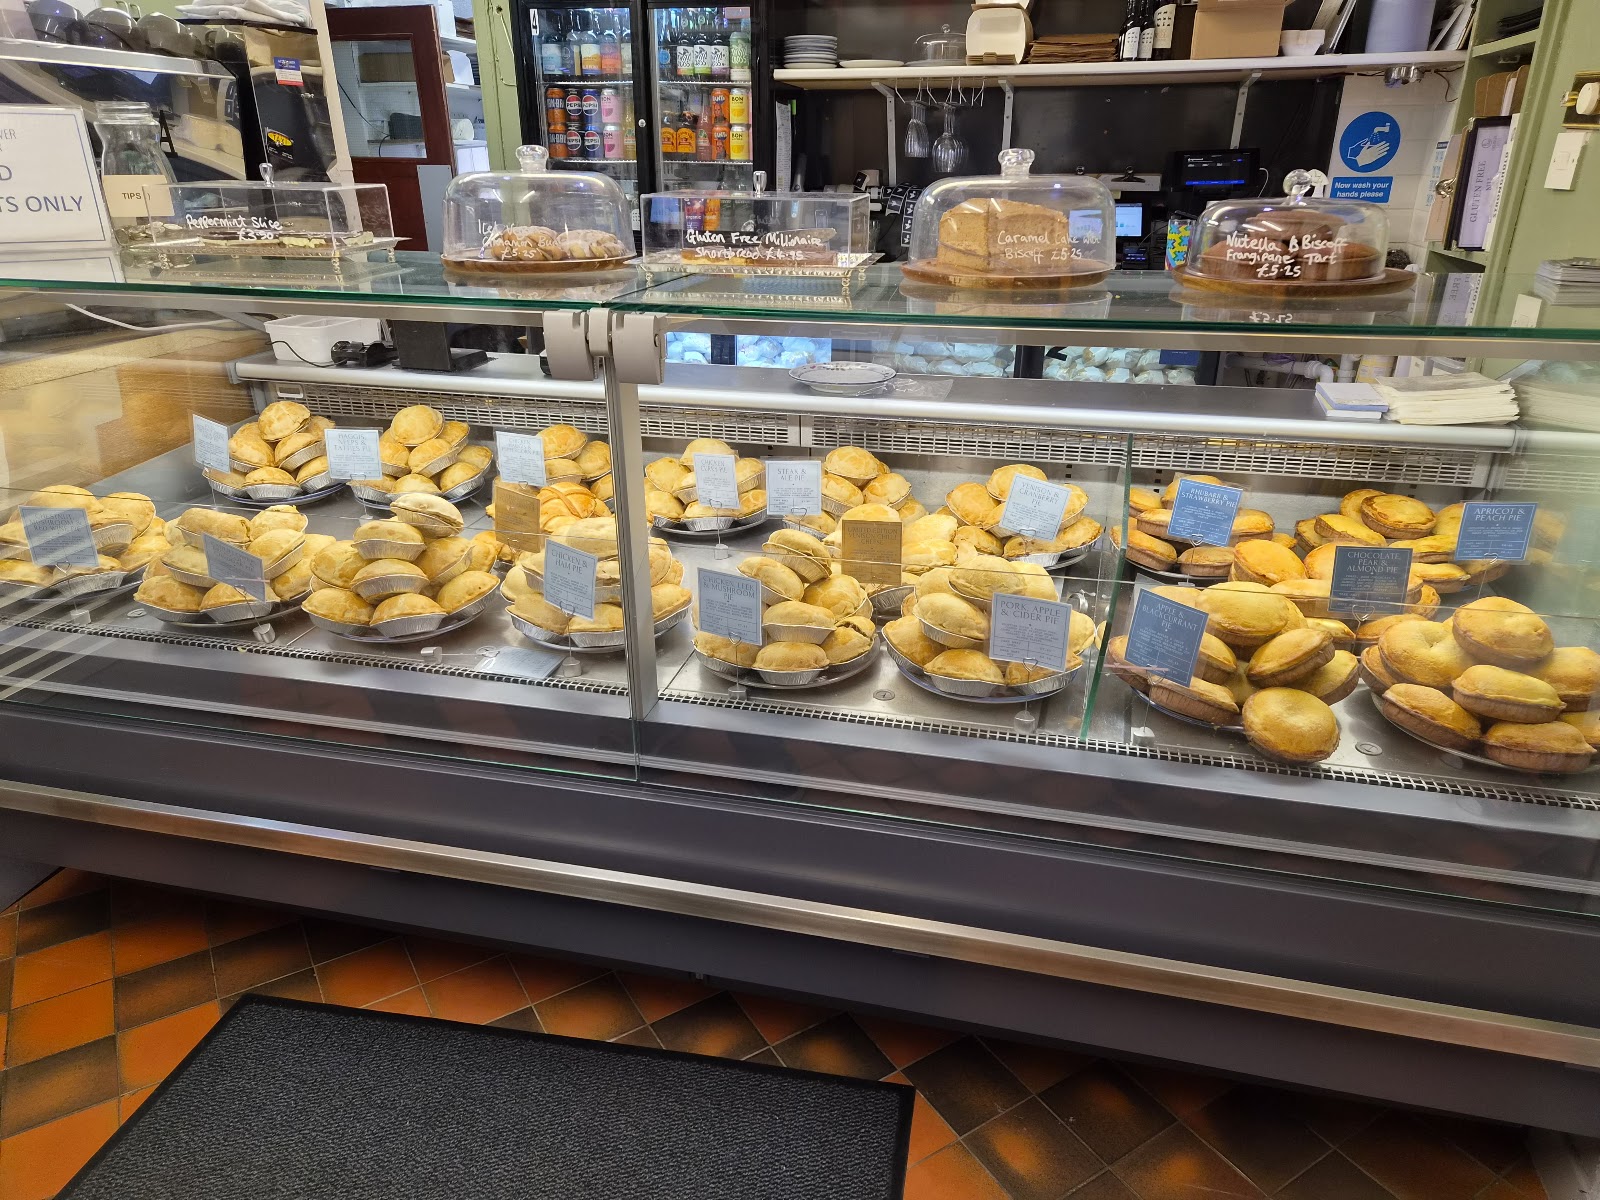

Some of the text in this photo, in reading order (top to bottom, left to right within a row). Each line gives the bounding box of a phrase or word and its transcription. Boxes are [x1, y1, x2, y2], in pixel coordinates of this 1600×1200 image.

[531, 10, 538, 34] 4
[1372, 182, 1390, 190] your
[1470, 160, 1486, 222] GLUTEN FREE
[122, 192, 142, 200] TIPS
[1360, 191, 1384, 199] please
[26, 196, 82, 212] ONLY
[186, 214, 283, 230] Peppermint Slice
[685, 229, 825, 247] Gluten Free Millionaire
[997, 231, 1049, 245] Caramel
[1054, 231, 1079, 244] Cake
[1226, 231, 1282, 252] Nutella
[1301, 235, 1348, 252] Biscoff
[694, 246, 764, 260] Shortbread
[1005, 248, 1044, 264] Biscoff
[1226, 251, 1338, 266] Frangipane Tart
[1019, 488, 1059, 505] CRANBERRY
[1022, 482, 1052, 496] VENISON
[1190, 488, 1221, 499] RHUBARB
[1031, 498, 1041, 506] PIE
[1181, 492, 1236, 508] STRAWBERRY PIE
[552, 549, 588, 568] CHICKEN &
[1347, 551, 1401, 560] CHOCOLATE
[555, 560, 582, 574] HAM PIE
[1347, 565, 1384, 573] ALMOND
[703, 576, 754, 591] CHICKEN LEEK
[712, 584, 755, 599] MUSHROOM
[1032, 606, 1060, 617] APPLE
[1155, 603, 1176, 615] APPLE
[1012, 610, 1042, 621] CIDER
[1045, 616, 1059, 625] PIE
[1142, 604, 1198, 631] BLACKCURRANT
[1161, 620, 1173, 630] PIE
